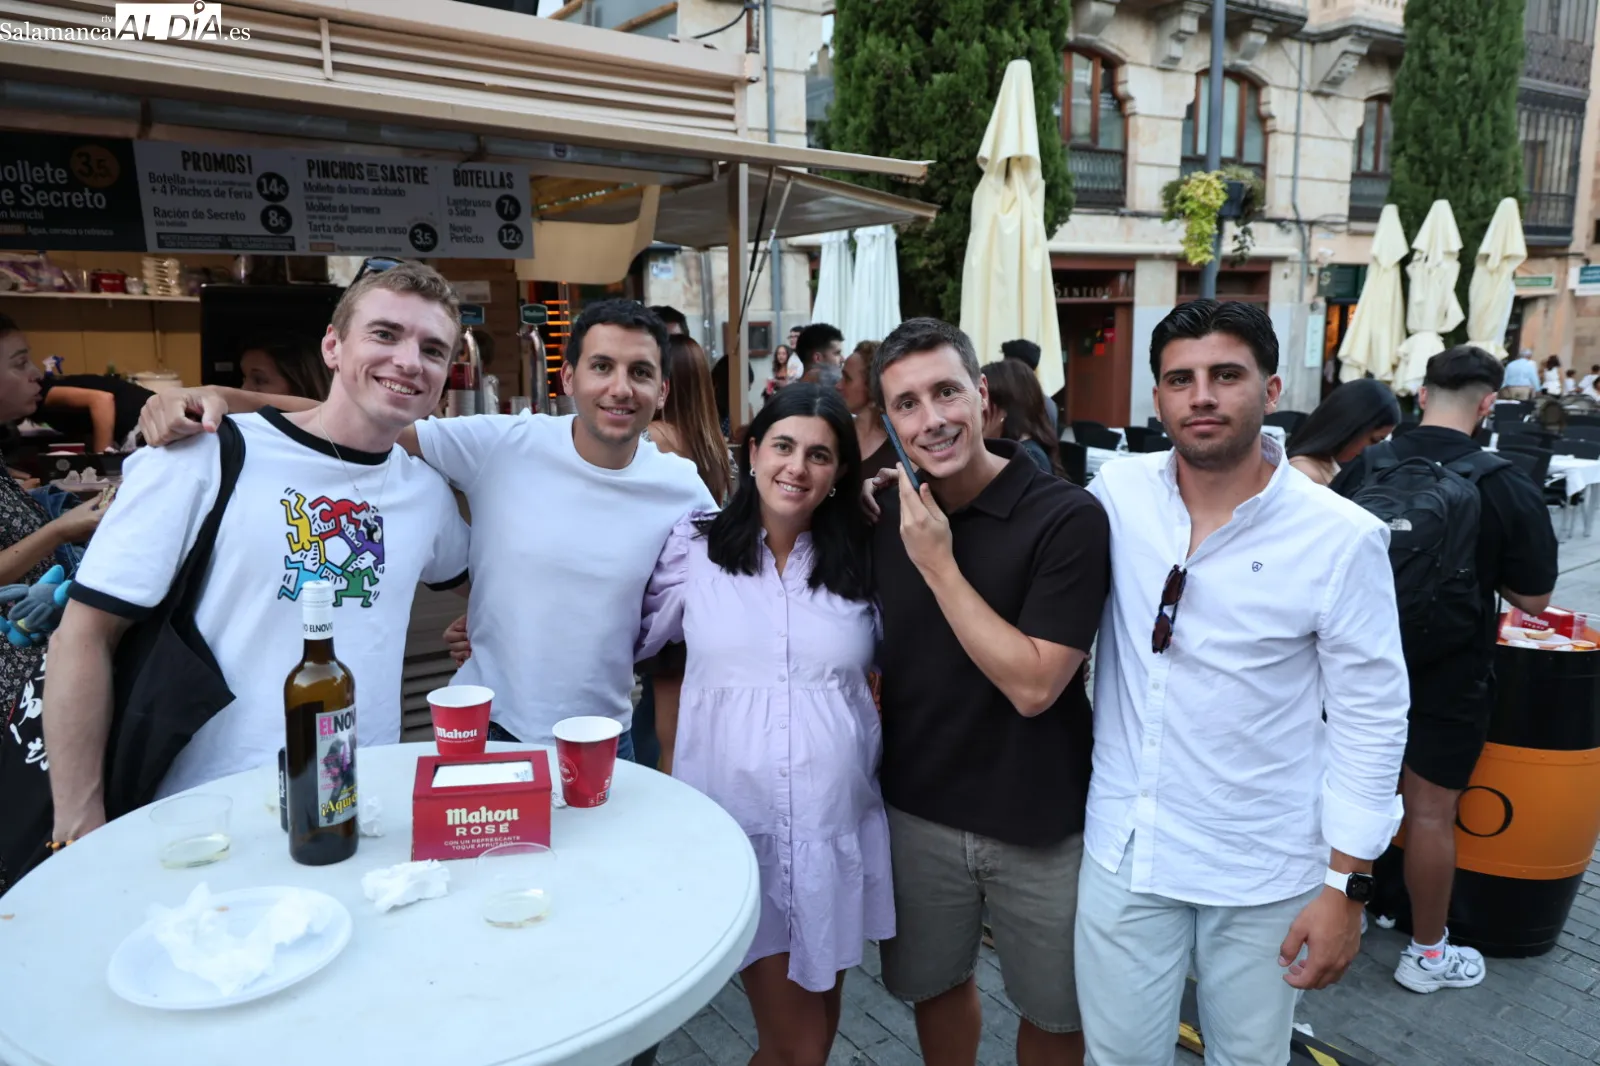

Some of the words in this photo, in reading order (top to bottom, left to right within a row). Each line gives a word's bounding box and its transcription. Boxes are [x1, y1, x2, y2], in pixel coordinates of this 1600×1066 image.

[180, 150, 253, 174] PROMOS!
[0, 159, 69, 185] ollete
[148, 172, 187, 186] Botella
[306, 158, 365, 181] PINCHOS
[380, 163, 429, 185] SASTRE
[453, 167, 514, 190] BOTELLAS
[0, 188, 15, 206] e
[19, 183, 107, 210] Secreto
[160, 184, 168, 197] 4
[170, 184, 213, 199] Pinchos
[214, 186, 227, 199] de
[228, 187, 254, 201] Feria
[303, 181, 336, 195] Mollete
[337, 183, 348, 196] de
[371, 186, 406, 199] adobado
[305, 201, 337, 214] Mollete
[338, 204, 349, 216] de
[447, 196, 492, 210] Lambrusco
[9, 207, 45, 220] kimchi
[153, 206, 190, 221] Ración
[191, 207, 206, 221] de
[207, 208, 246, 223] Secreto
[308, 221, 332, 235] Tarta
[333, 223, 345, 236] de
[346, 225, 373, 240] queso
[374, 226, 386, 237] en
[387, 226, 408, 239] vaso
[449, 222, 473, 234] Novio
[450, 232, 484, 245] Perfecto
[435, 726, 478, 740] Mahou
[445, 806, 520, 826] Mahou
